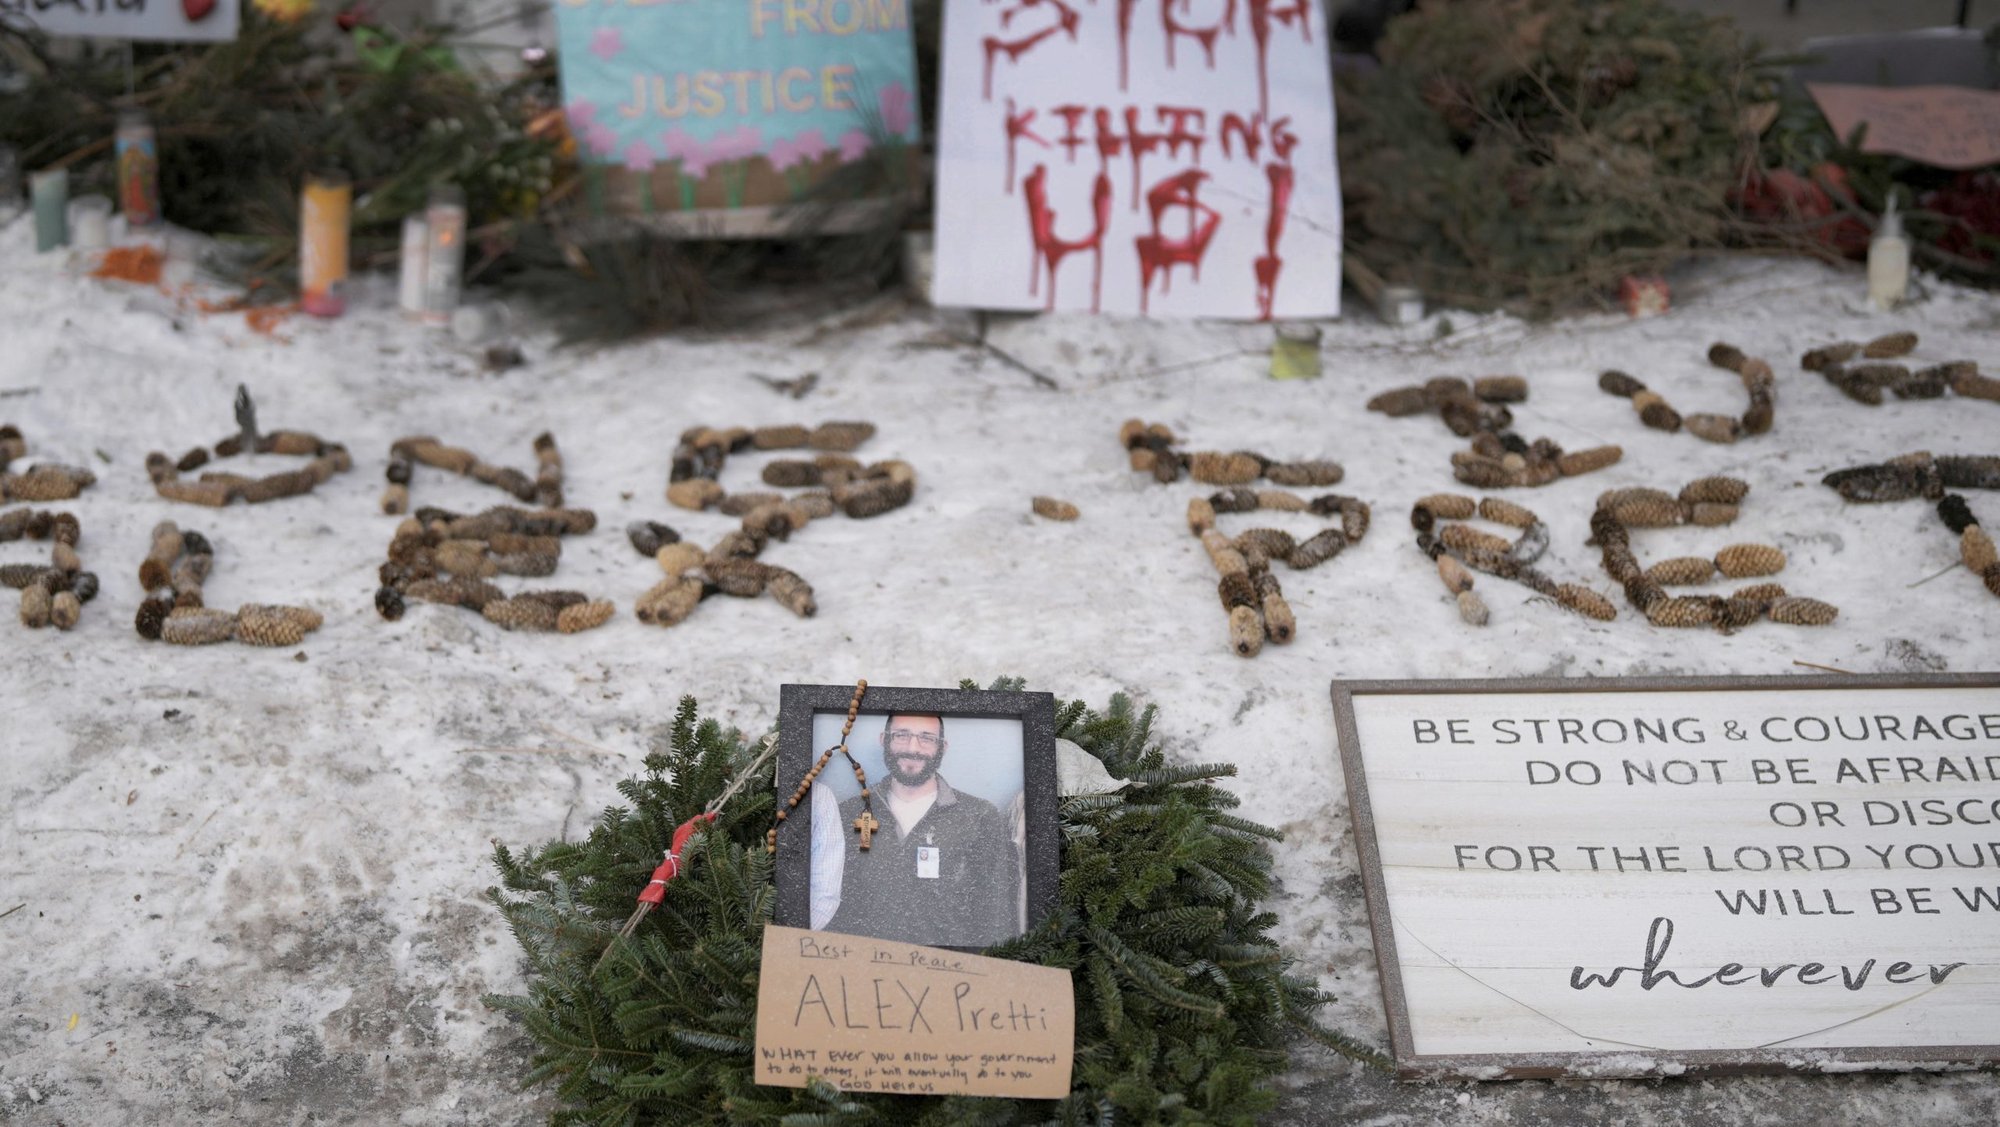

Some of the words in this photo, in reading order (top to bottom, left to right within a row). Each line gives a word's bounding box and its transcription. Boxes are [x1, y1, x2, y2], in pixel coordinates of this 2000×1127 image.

[751, 0, 909, 38] FROM
[618, 63, 856, 119] JUSTICE
[1004, 98, 1299, 168] KILLING
[1023, 163, 1294, 316] US!
[1412, 719, 1475, 744] BE
[1491, 717, 1706, 744] STRONG
[1723, 719, 1749, 741] &
[1760, 714, 2000, 743] COURAGE
[1525, 760, 1602, 786] DO
[1621, 759, 1729, 786] NOT
[1751, 758, 1817, 785] BE
[1769, 801, 1846, 828] OR
[1862, 799, 2000, 826] DISC
[1453, 845, 1561, 872] FOR
[1576, 846, 1688, 873] THE
[1702, 845, 1852, 873] LORD
[1714, 888, 1855, 917] WILL
[1870, 888, 1941, 915] BE
[873, 946, 893, 960] in
[909, 950, 964, 971] Peace
[1570, 917, 1967, 992] wherever
[794, 973, 933, 1034] ALEX
[954, 981, 1047, 1032] Pretti
[761, 1047, 817, 1061] WHAT
[871, 1051, 895, 1065] you
[903, 1051, 938, 1063] allow
[945, 1053, 973, 1067] your
[767, 1062, 782, 1074] to
[789, 1061, 802, 1074] do
[807, 1064, 818, 1074] to
[864, 1066, 877, 1077] it
[881, 1064, 902, 1077] will
[908, 1067, 968, 1085] eventually
[977, 1069, 989, 1079] do
[994, 1069, 1007, 1079] to
[1011, 1070, 1033, 1082] you
[839, 1078, 872, 1090] GOD
